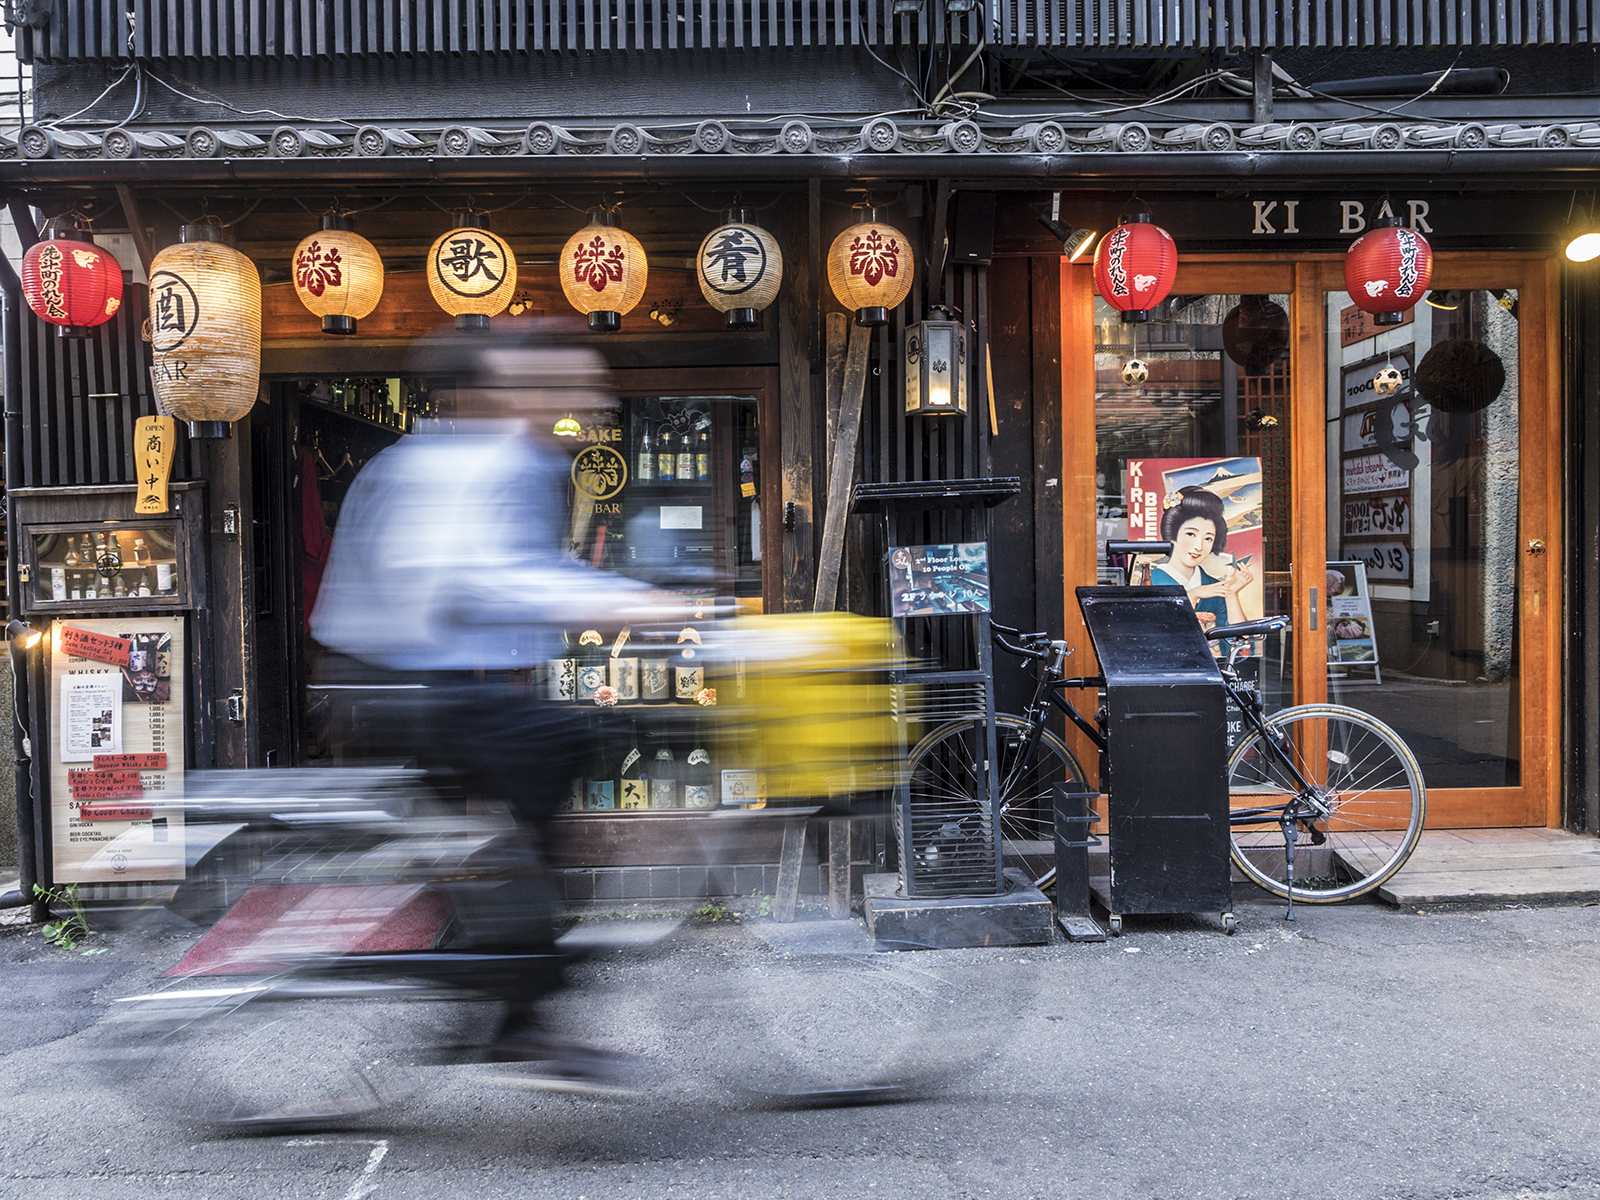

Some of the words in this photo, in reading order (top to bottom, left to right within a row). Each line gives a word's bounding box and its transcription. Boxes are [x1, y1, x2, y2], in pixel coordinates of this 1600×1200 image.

[1253, 201, 1299, 234] KI
[1340, 201, 1433, 234] BAR
[40, 246, 67, 317] 先斗町のれん会
[442, 238, 499, 282] 歌
[707, 232, 761, 283] 肴
[1109, 229, 1129, 296] 先斗町のれん会
[1397, 229, 1419, 297] 先斗町のれん会
[576, 429, 622, 442] SAKE
[145, 435, 161, 490] 商い中
[595, 504, 620, 513] BAR
[1130, 462, 1143, 528] KIRIN
[1145, 492, 1157, 541] BEE
[1229, 681, 1255, 692] CHARGE
[95, 808, 117, 816] Cover
[120, 807, 150, 816] Charge
